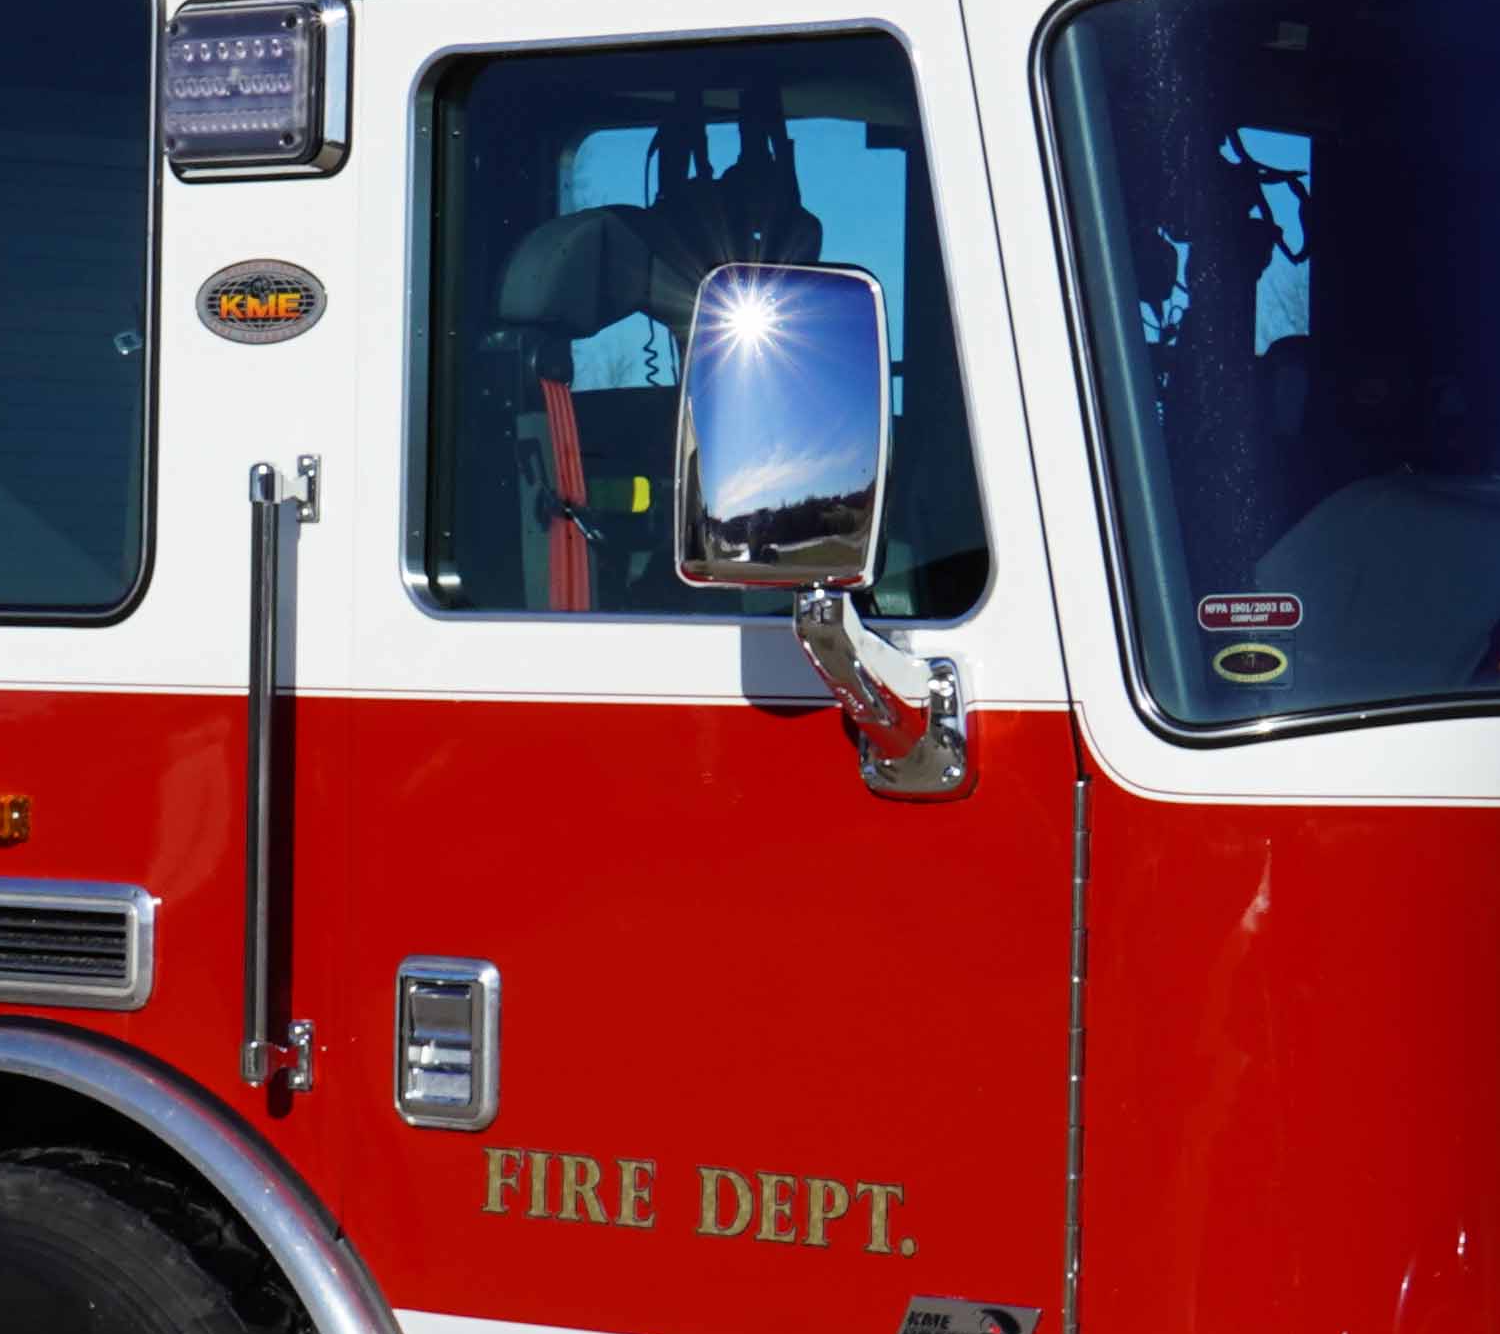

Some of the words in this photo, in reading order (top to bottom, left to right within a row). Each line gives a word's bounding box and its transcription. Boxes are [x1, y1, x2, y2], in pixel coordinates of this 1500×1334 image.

[218, 291, 303, 322] KME
[1230, 601, 1277, 614] 1901/2003
[480, 1145, 657, 1229] FIRE
[694, 1164, 919, 1258] DEPT.
[908, 1310, 952, 1330] KME
